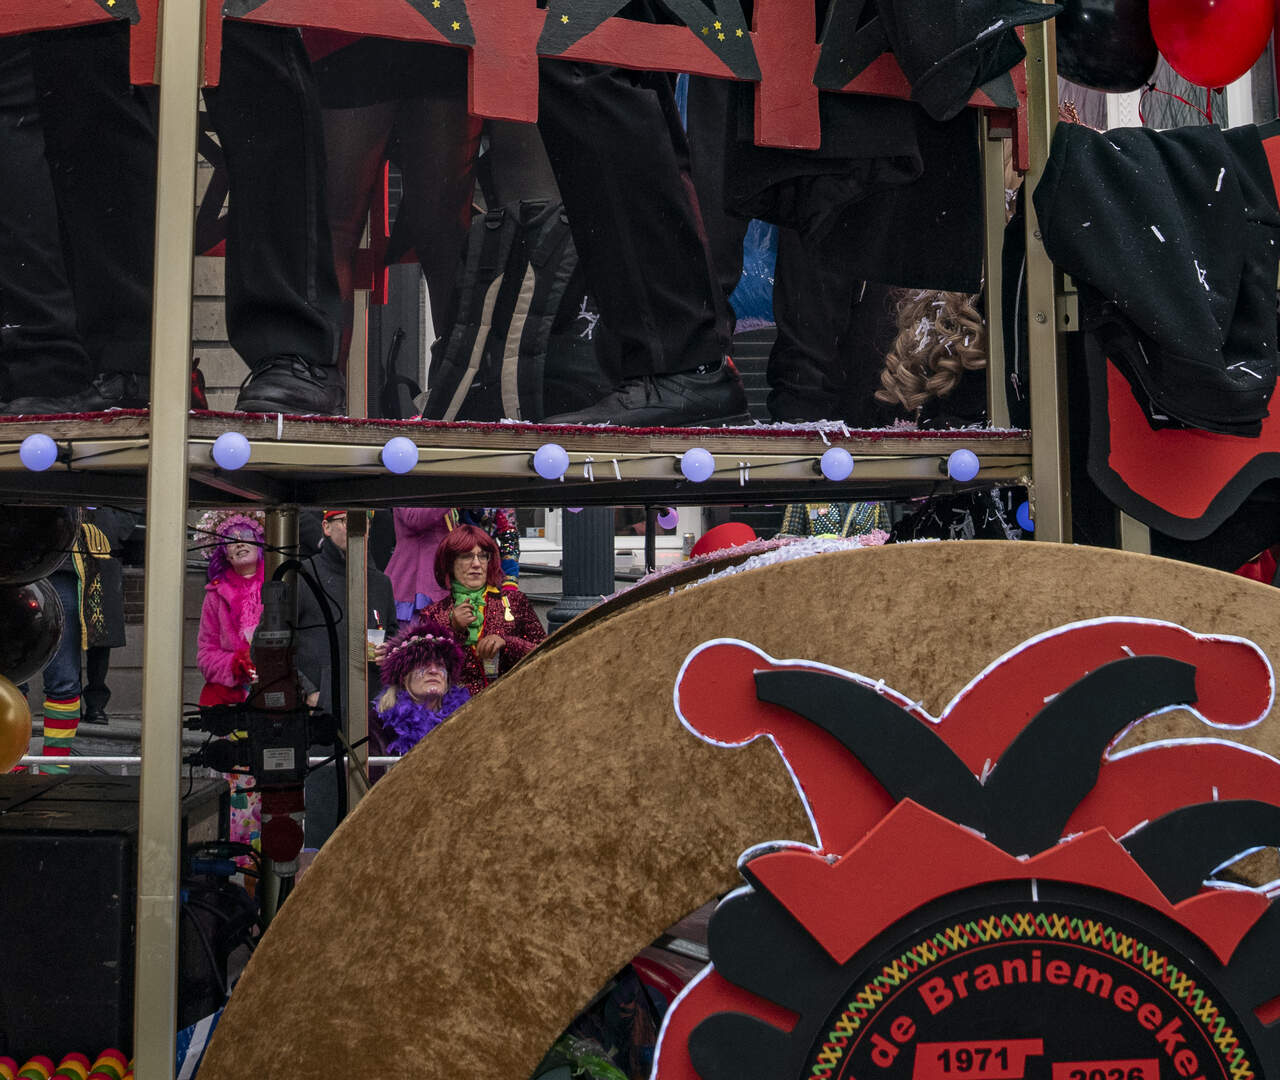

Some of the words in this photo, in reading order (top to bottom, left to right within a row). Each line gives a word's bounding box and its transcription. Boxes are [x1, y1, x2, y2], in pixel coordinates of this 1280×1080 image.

[871, 1015, 917, 1068] de
[918, 950, 1209, 1080] Braniemeeke
[937, 1047, 1009, 1073] 1971
